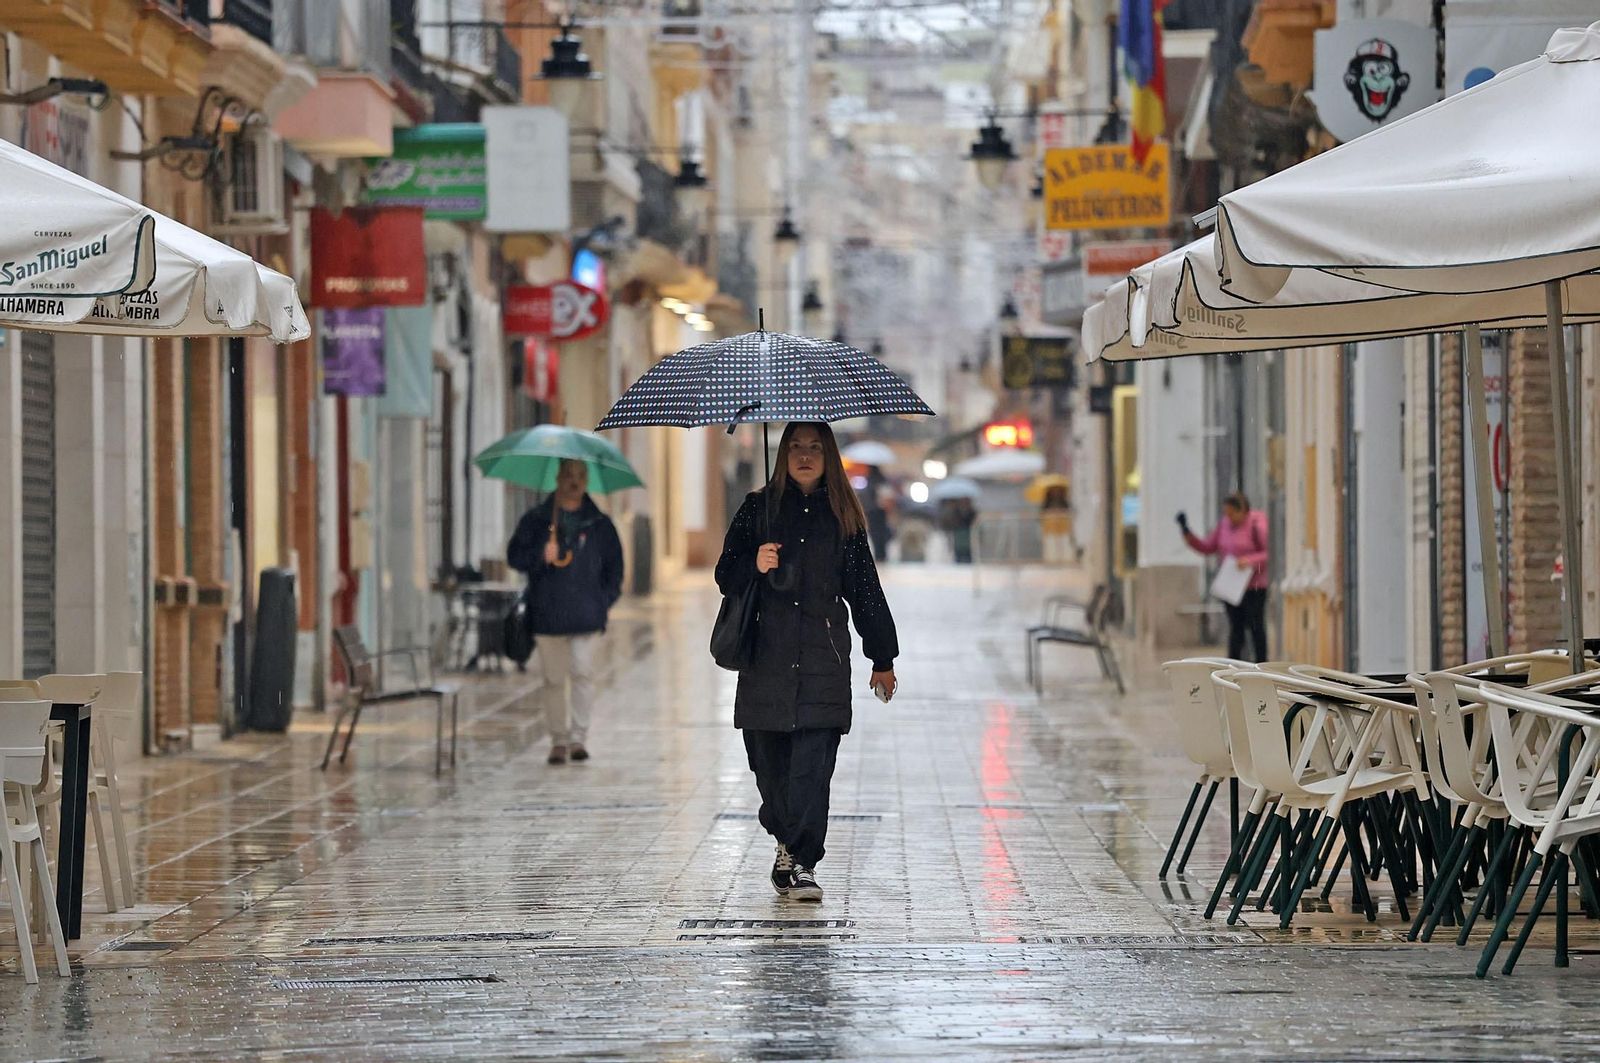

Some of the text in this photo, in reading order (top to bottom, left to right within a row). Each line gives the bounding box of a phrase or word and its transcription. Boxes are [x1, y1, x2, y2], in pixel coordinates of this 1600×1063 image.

[34, 230, 73, 238] CERVEZAS
[0, 234, 107, 286] SanMiguel
[30, 282, 76, 290] SINCE 1890
[0, 297, 65, 316] LHAMBRA
